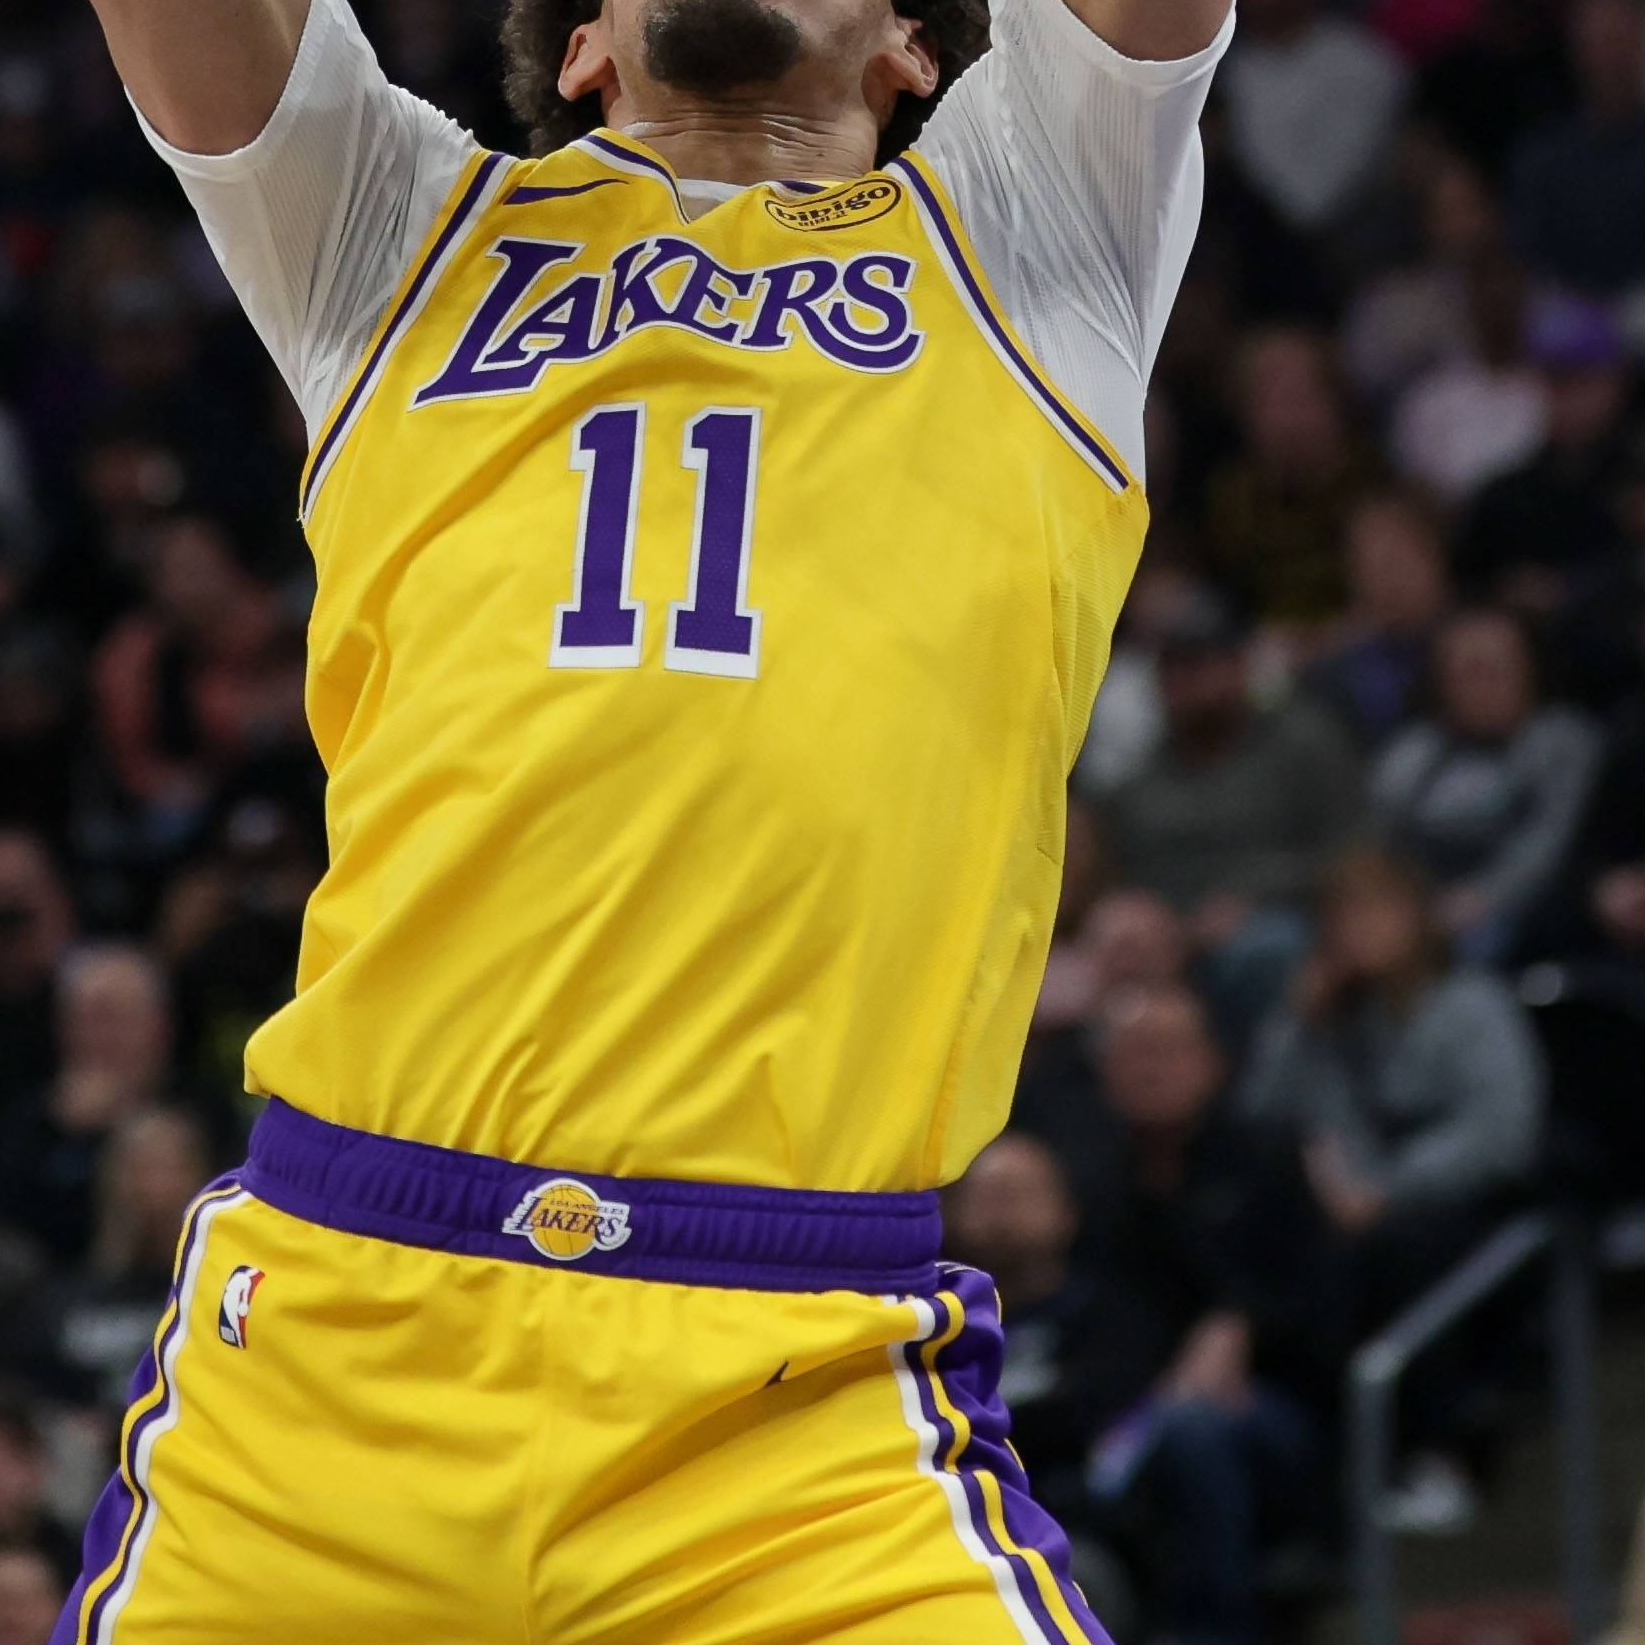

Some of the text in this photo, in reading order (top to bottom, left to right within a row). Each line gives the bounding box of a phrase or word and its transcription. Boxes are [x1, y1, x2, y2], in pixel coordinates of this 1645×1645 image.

[775, 186, 891, 222] bibigo
[408, 236, 928, 412] LAKERS
[548, 401, 763, 680] 11
[504, 1196, 632, 1247] LAKERS
